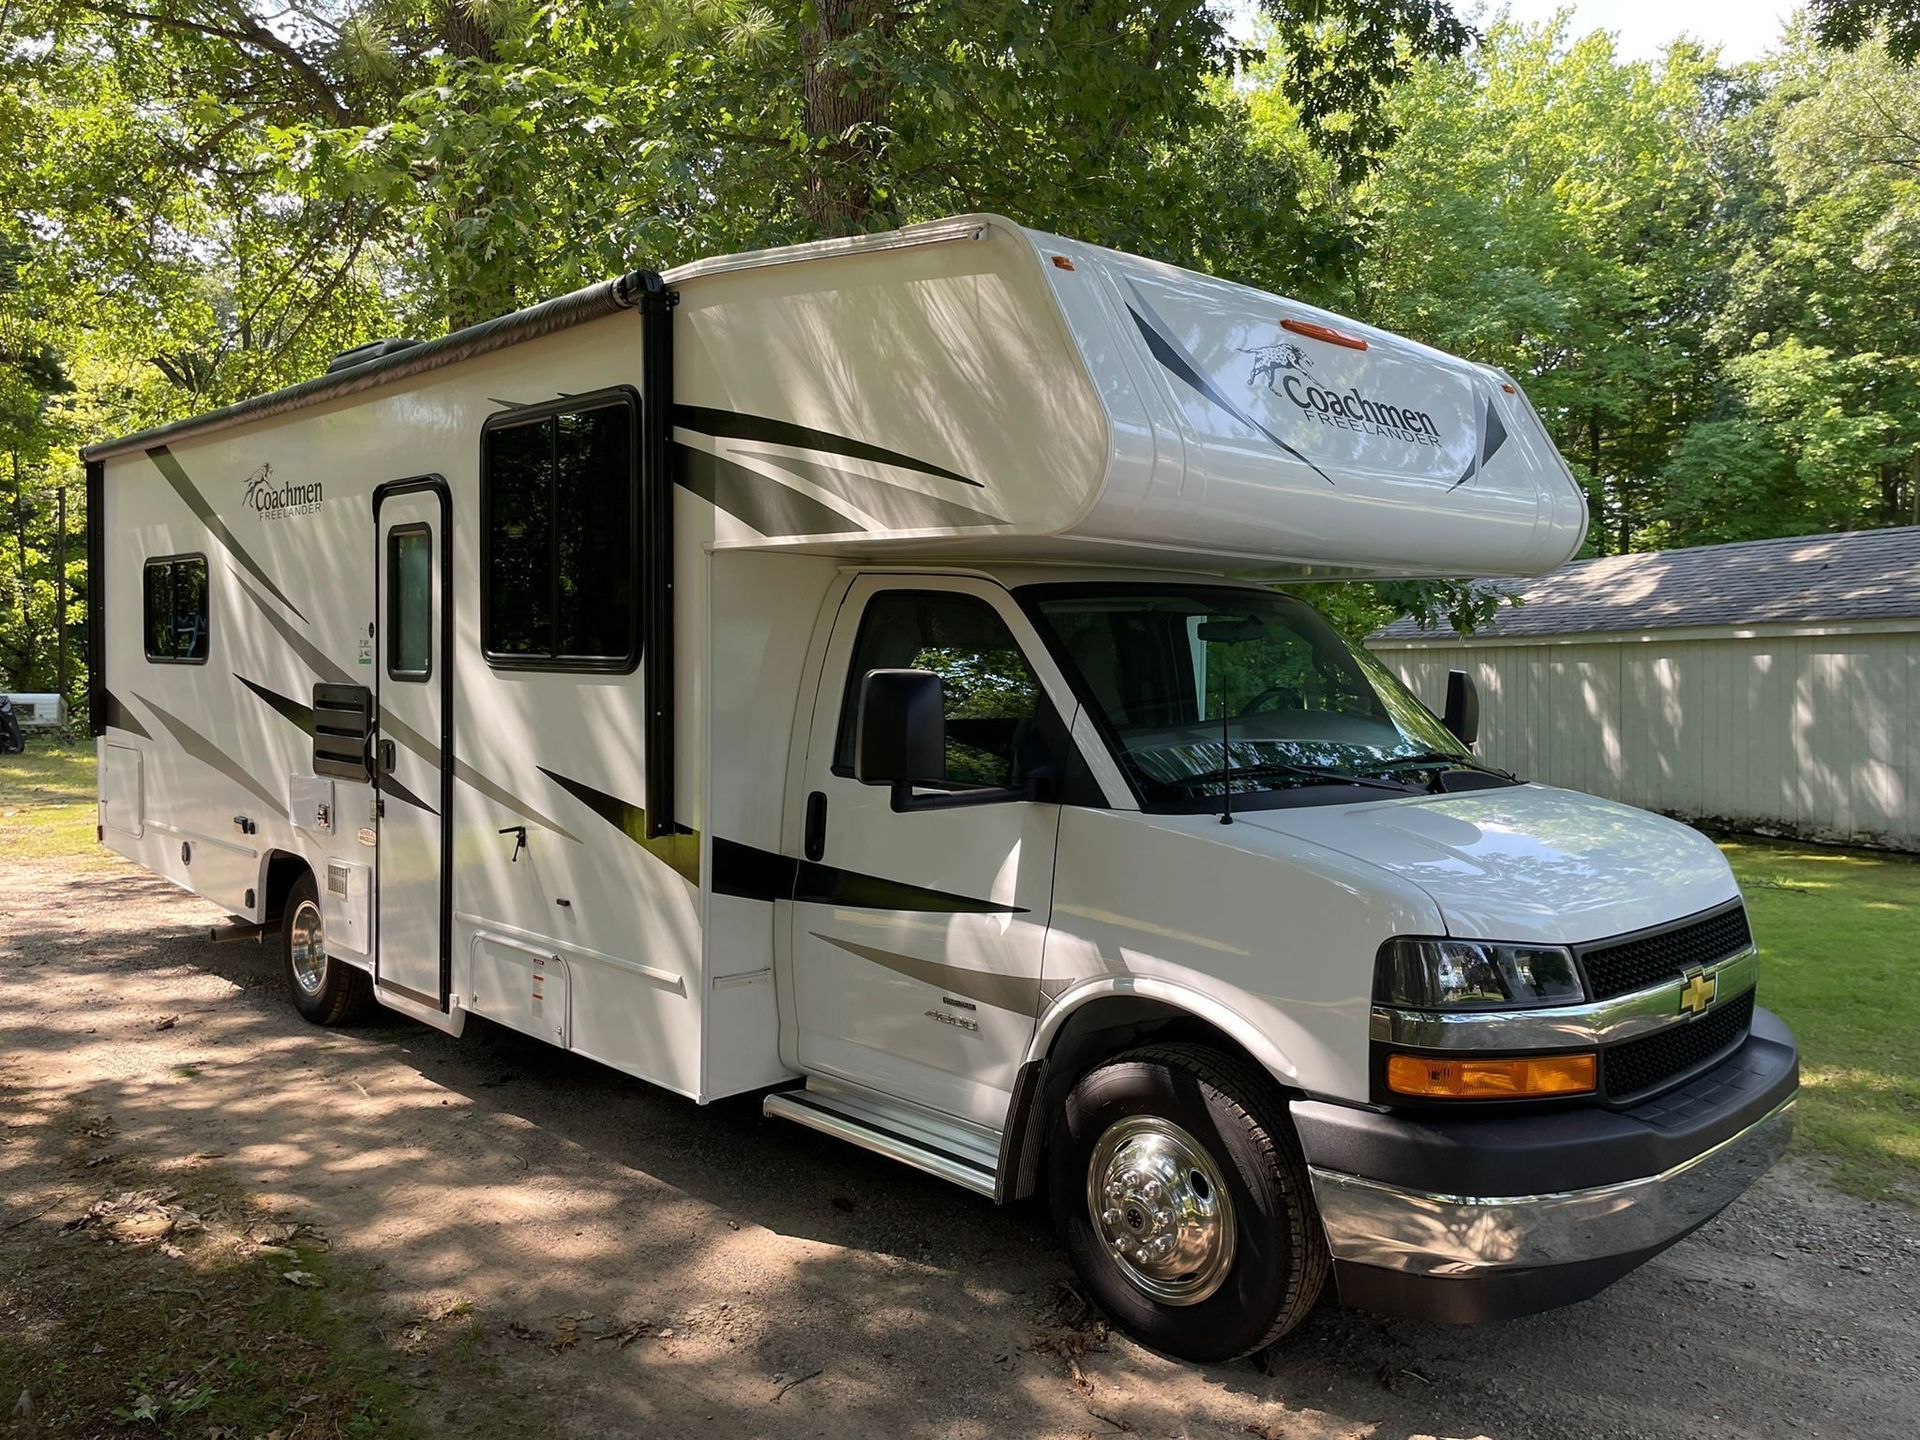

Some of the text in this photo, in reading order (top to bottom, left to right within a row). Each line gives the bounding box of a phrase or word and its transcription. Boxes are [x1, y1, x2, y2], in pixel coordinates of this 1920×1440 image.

[1282, 375, 1441, 437] Coachmen
[1303, 409, 1443, 448] FREELANDER
[255, 480, 323, 512] Coachmen
[259, 502, 323, 522] FREELANDER
